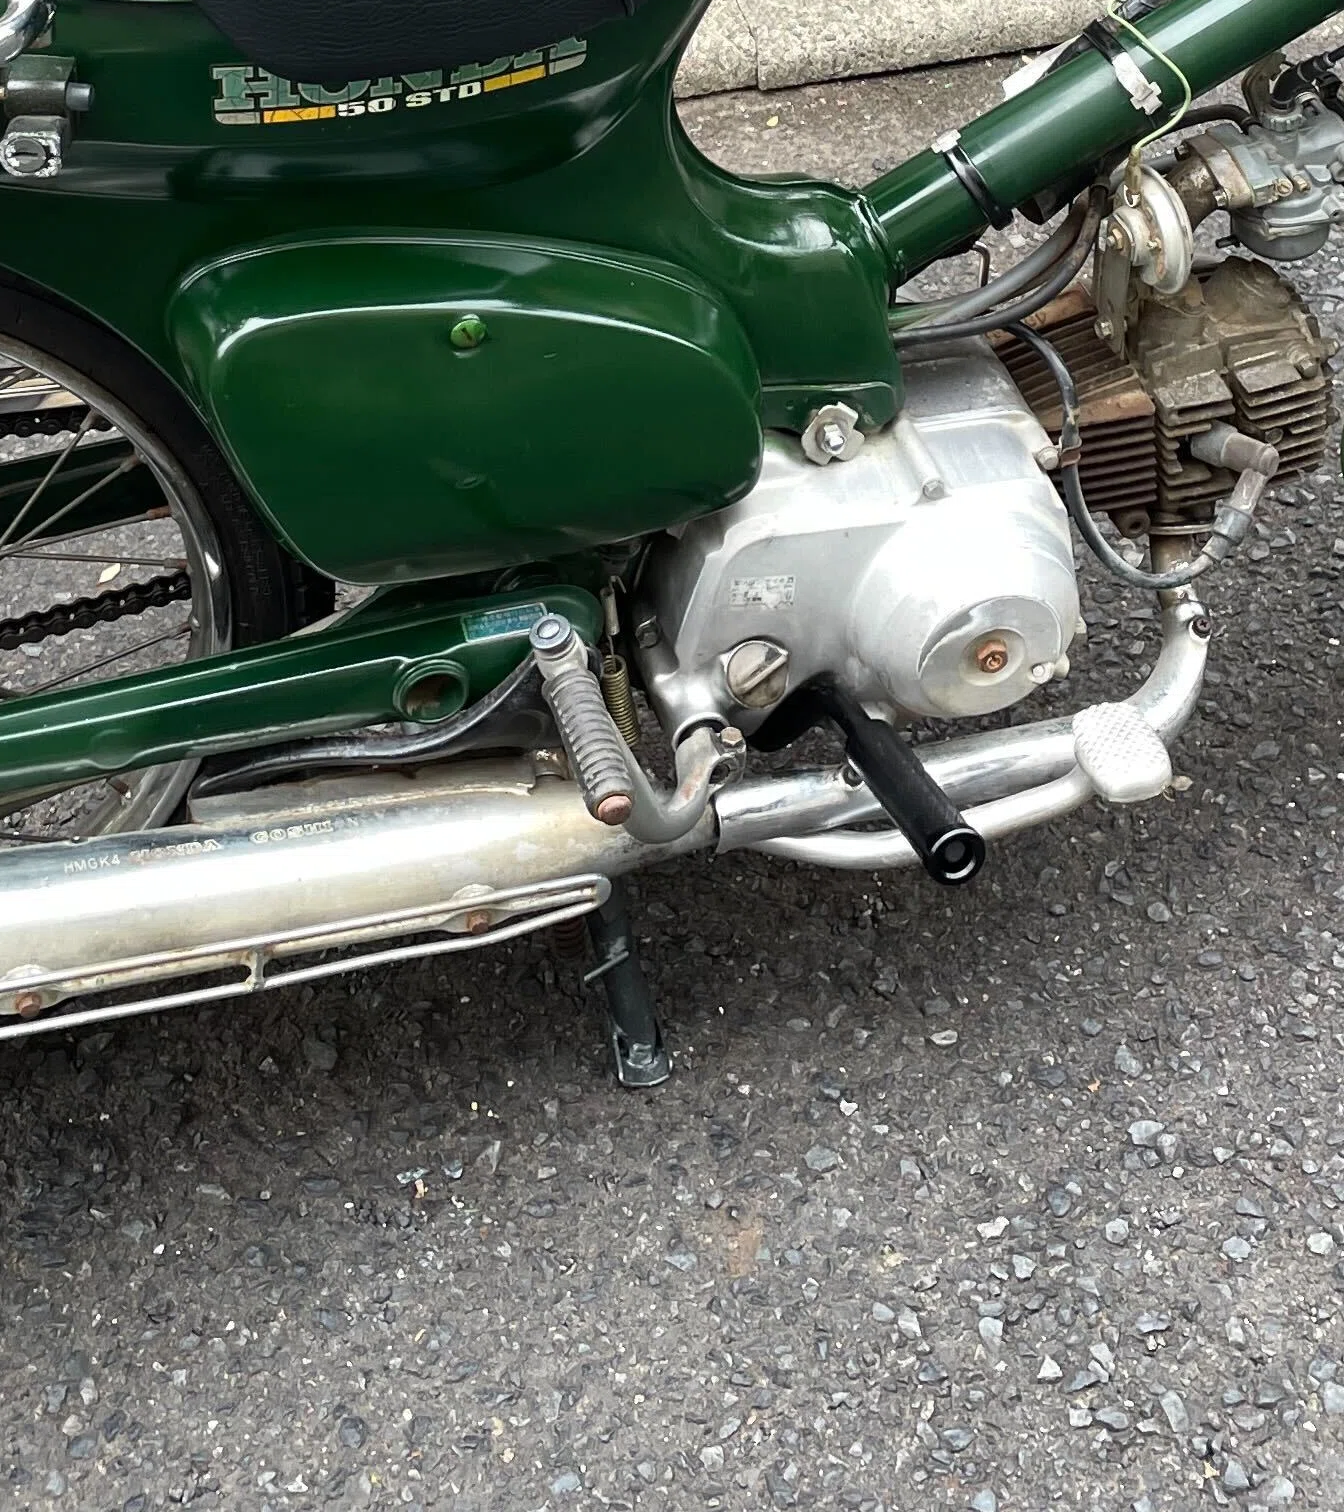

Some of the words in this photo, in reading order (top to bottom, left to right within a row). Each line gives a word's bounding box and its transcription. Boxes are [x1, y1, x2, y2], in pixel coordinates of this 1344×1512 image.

[337, 97, 397, 117] 50
[405, 81, 482, 108] STD
[63, 853, 121, 874] HMGK4
